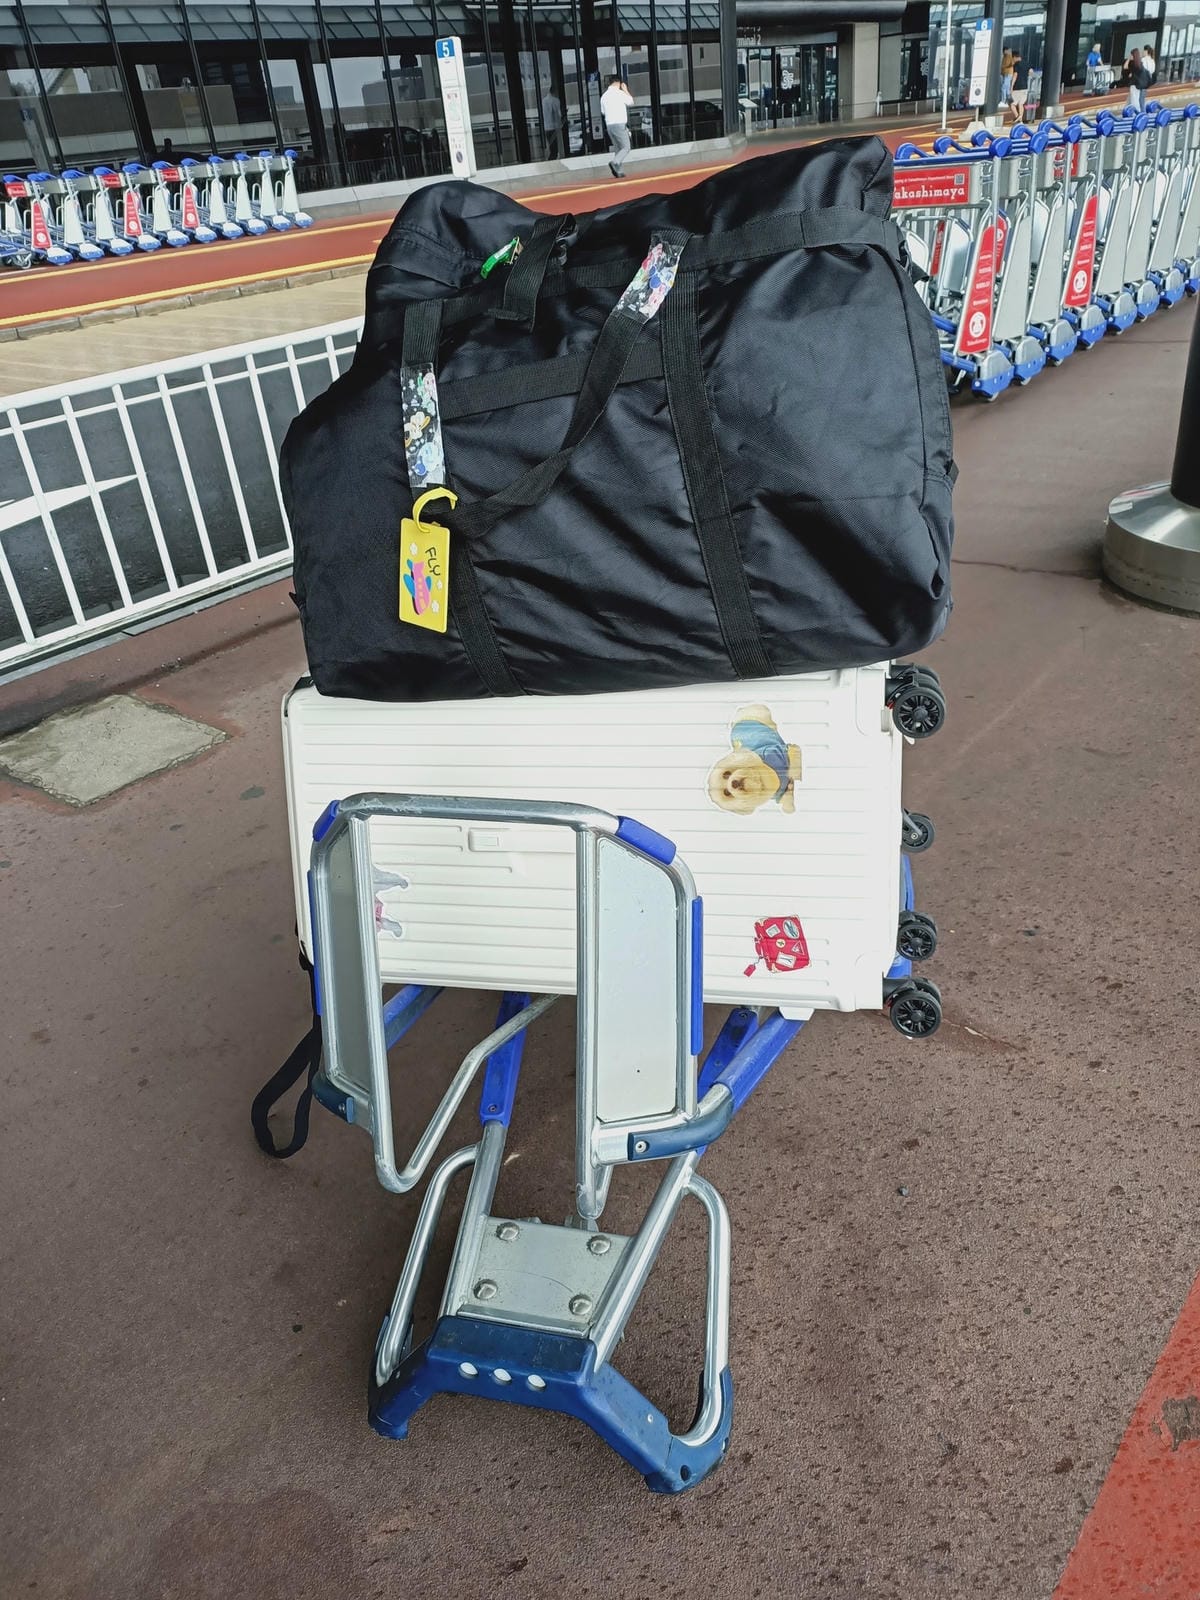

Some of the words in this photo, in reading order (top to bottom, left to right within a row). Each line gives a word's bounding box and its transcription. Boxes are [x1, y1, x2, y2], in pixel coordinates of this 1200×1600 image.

[981, 20, 988, 30] 6
[442, 41, 449, 57] 5
[894, 184, 965, 200] akashimaya
[425, 547, 441, 576] FLY
